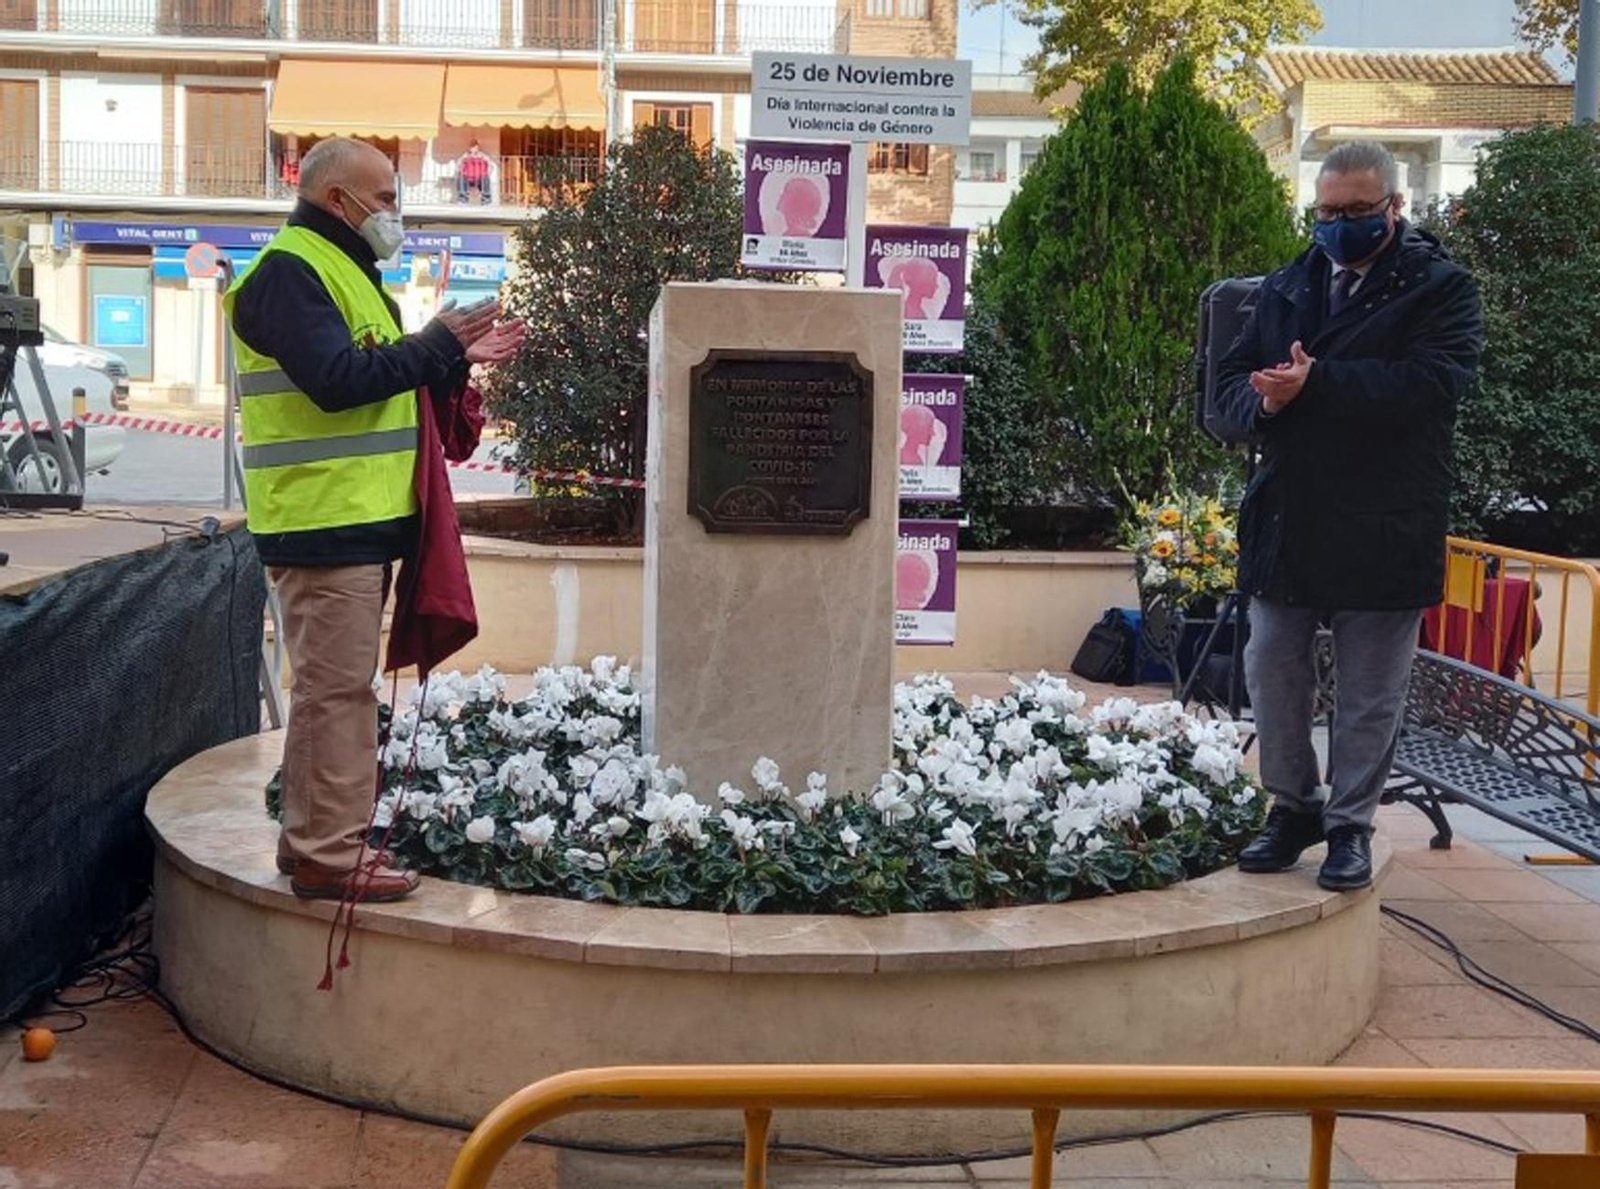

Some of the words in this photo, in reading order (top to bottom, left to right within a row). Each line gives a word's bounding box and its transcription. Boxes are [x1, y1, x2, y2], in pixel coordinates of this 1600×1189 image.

[770, 61, 796, 81] 25
[803, 63, 830, 82] de
[837, 65, 954, 87] Noviembre
[766, 97, 790, 110] Día
[794, 98, 889, 115] Internacional
[892, 103, 939, 117] contra
[943, 104, 956, 117] la
[788, 116, 854, 132] Violencia
[858, 119, 877, 133] de
[881, 119, 933, 134] Género
[751, 153, 842, 175] Asesinada
[116, 227, 149, 238] VITAL
[152, 229, 183, 239] DENT
[250, 231, 276, 241] VITA
[870, 238, 960, 258] Asesinada
[901, 387, 957, 406] sinada
[897, 533, 951, 551] sinada
